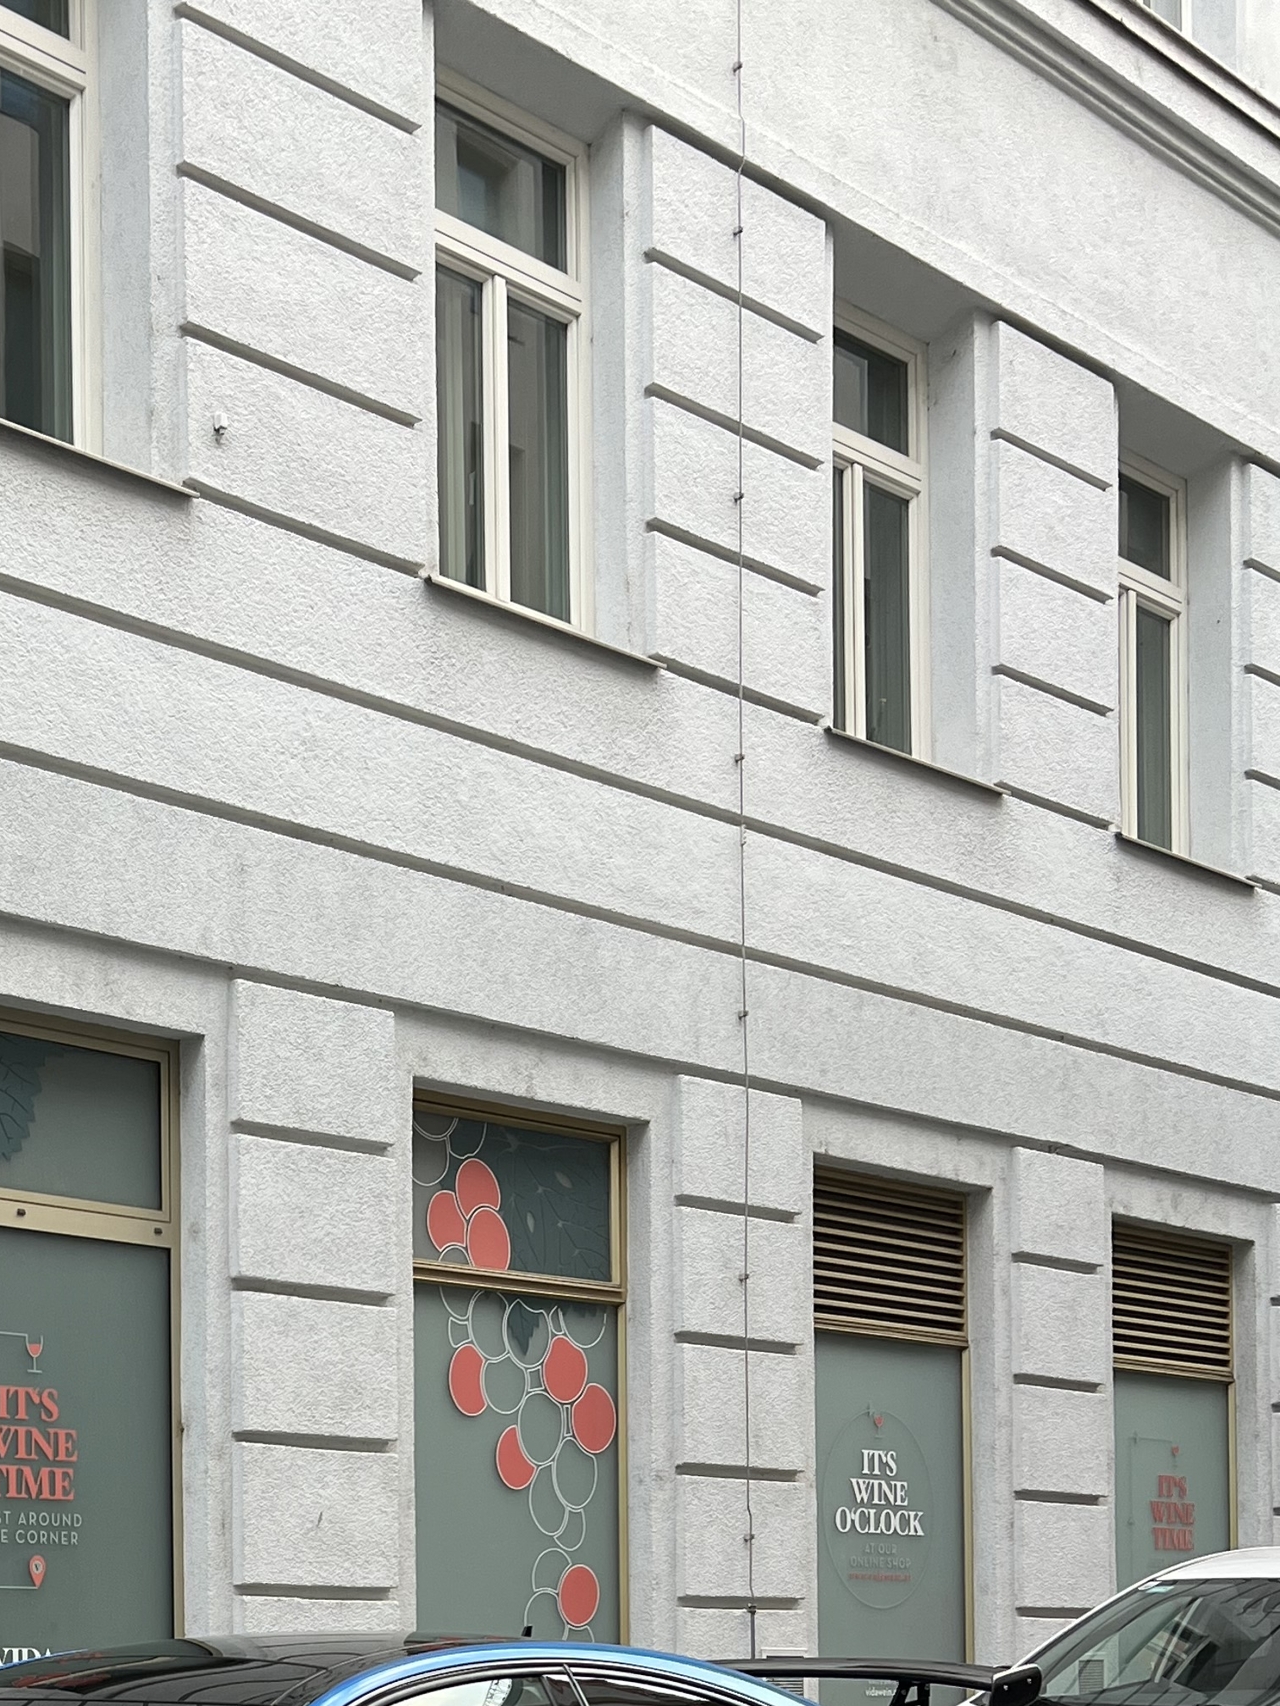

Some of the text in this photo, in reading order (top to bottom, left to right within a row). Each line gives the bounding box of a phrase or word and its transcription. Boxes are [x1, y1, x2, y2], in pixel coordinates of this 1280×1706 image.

[850, 1477, 909, 1507] WINE
[18, 1511, 83, 1528] AROUND
[835, 1506, 925, 1537] O'CLOCK
[1150, 1500, 1195, 1526] WINE
[15, 1529, 79, 1546] CORNER
[1152, 1526, 1195, 1551] TIME
[865, 1543, 898, 1555] AT OUR
[850, 1555, 912, 1569] ONLINE SHOP
